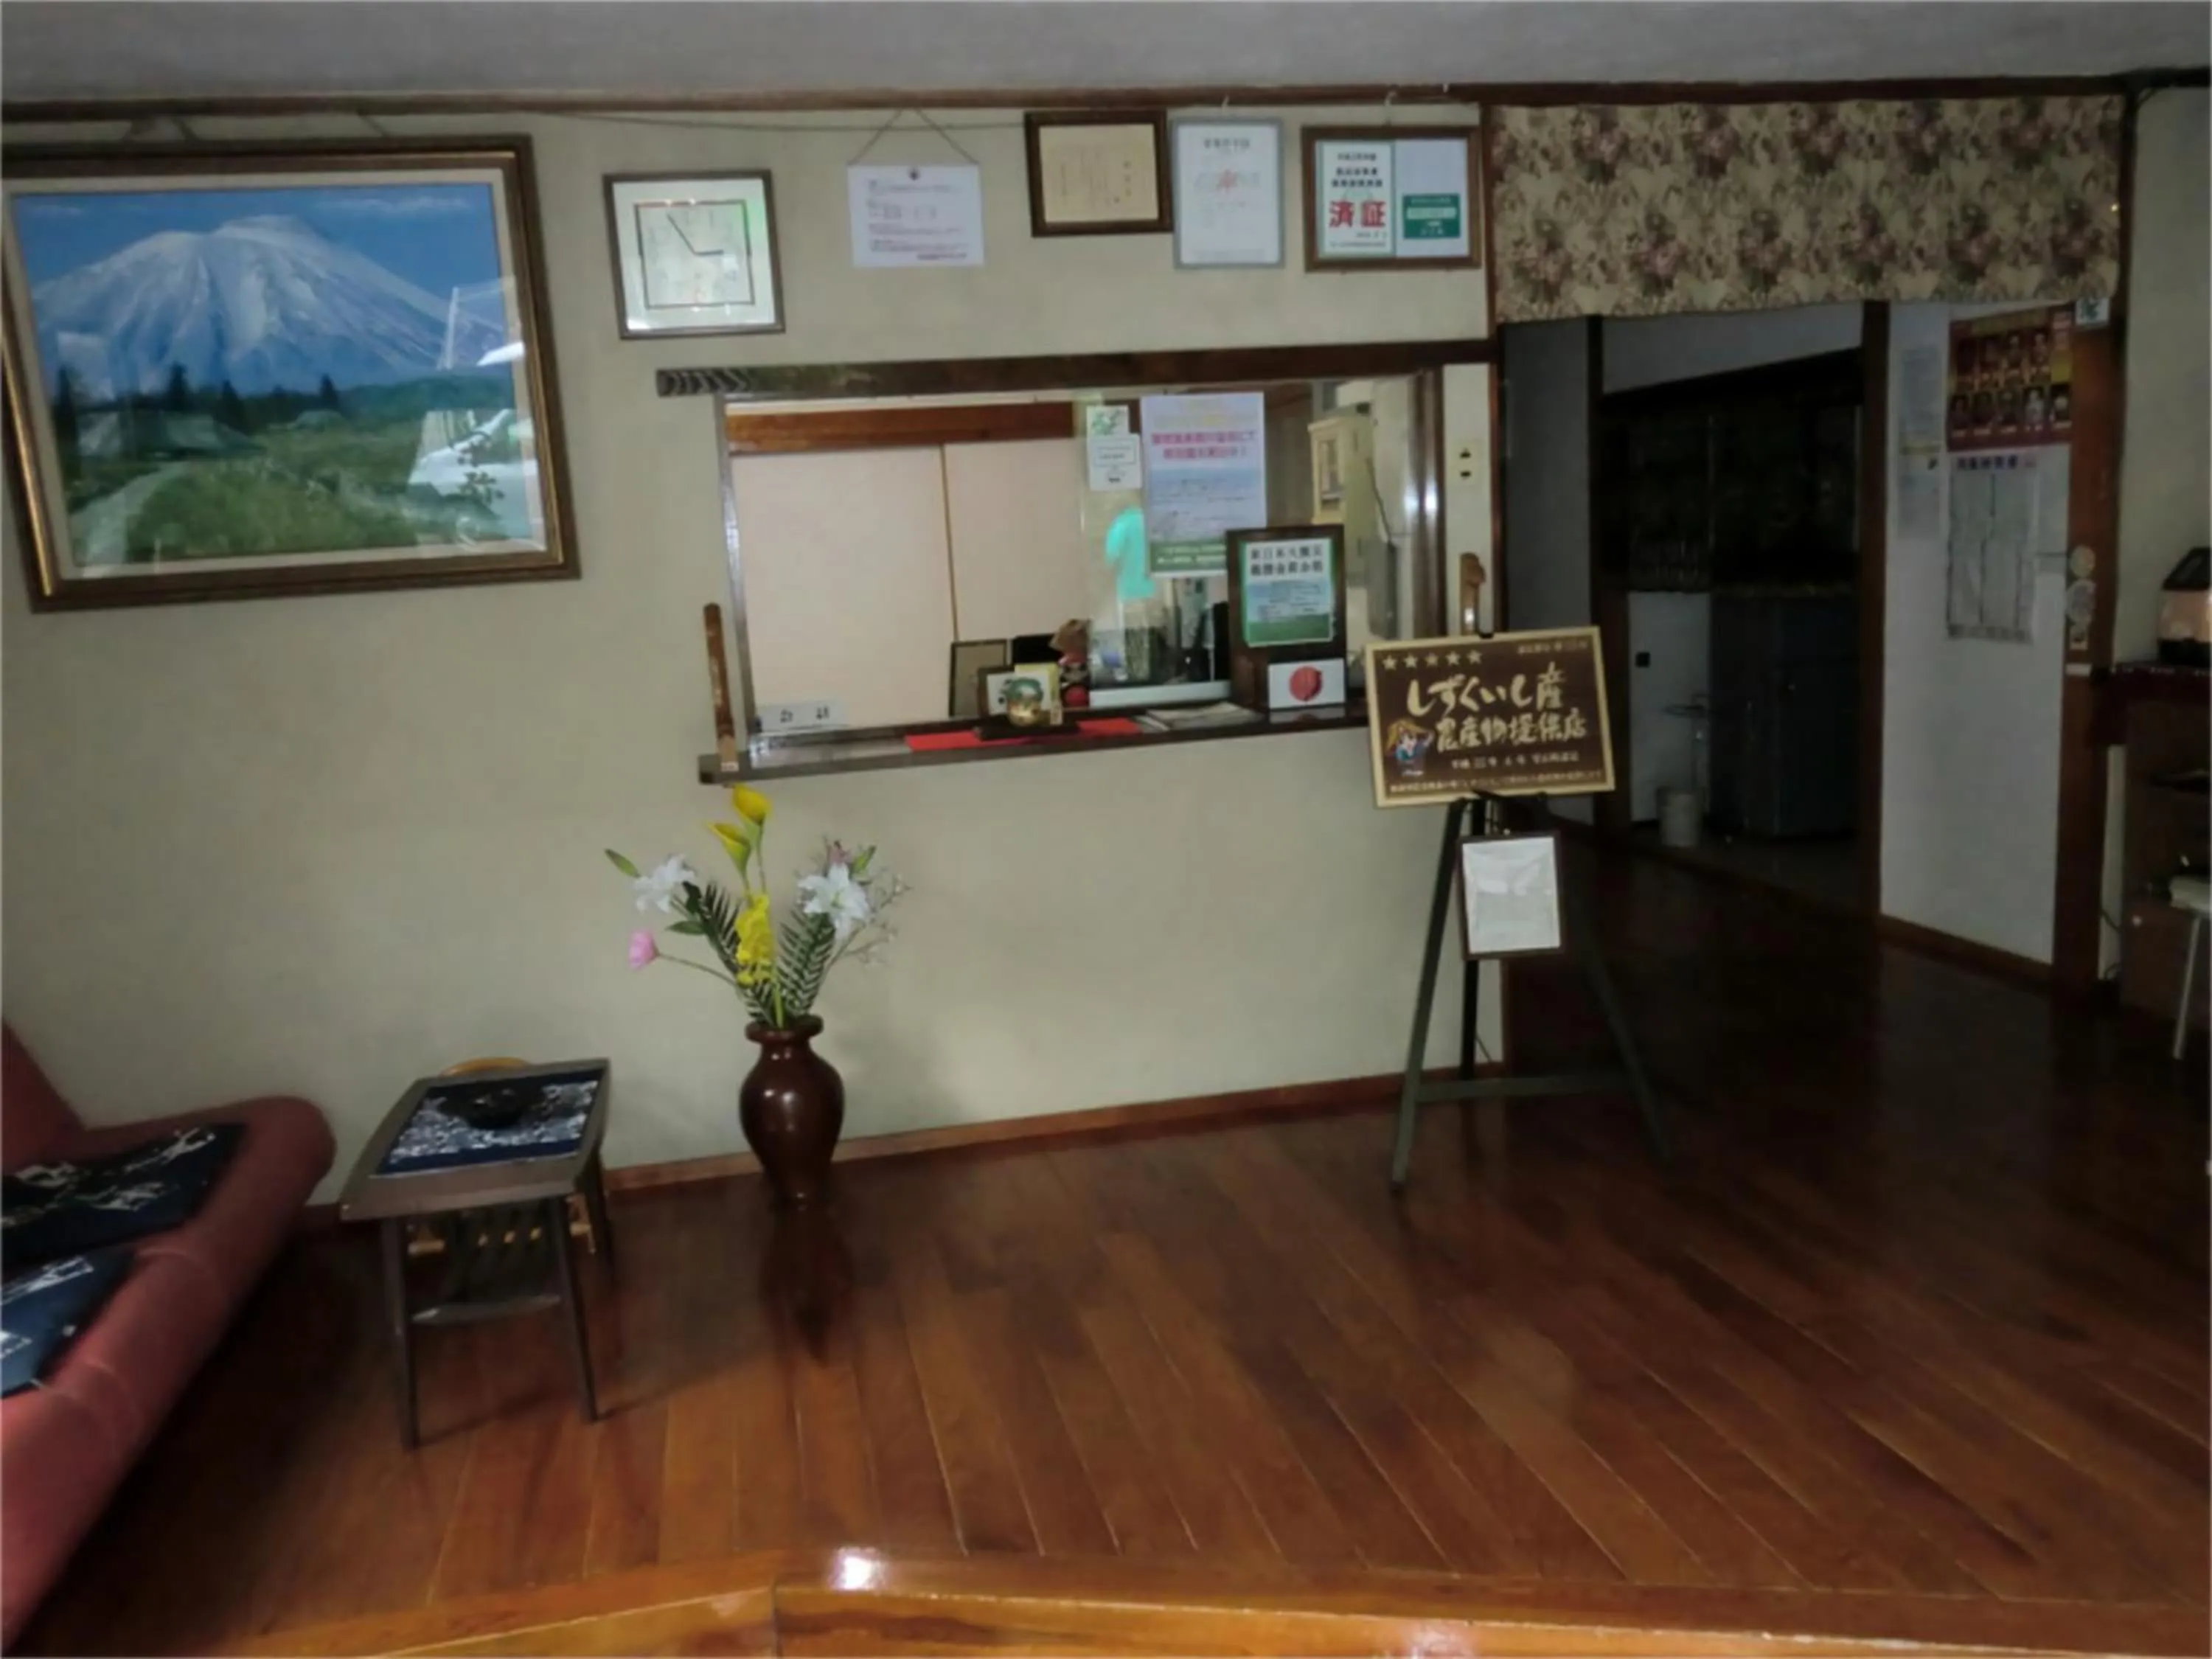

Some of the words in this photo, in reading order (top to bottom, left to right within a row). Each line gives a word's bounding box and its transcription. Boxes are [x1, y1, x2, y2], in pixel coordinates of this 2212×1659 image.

[1329, 200, 1387, 228] 済証
[1407, 662, 1564, 718] しずくいし産
